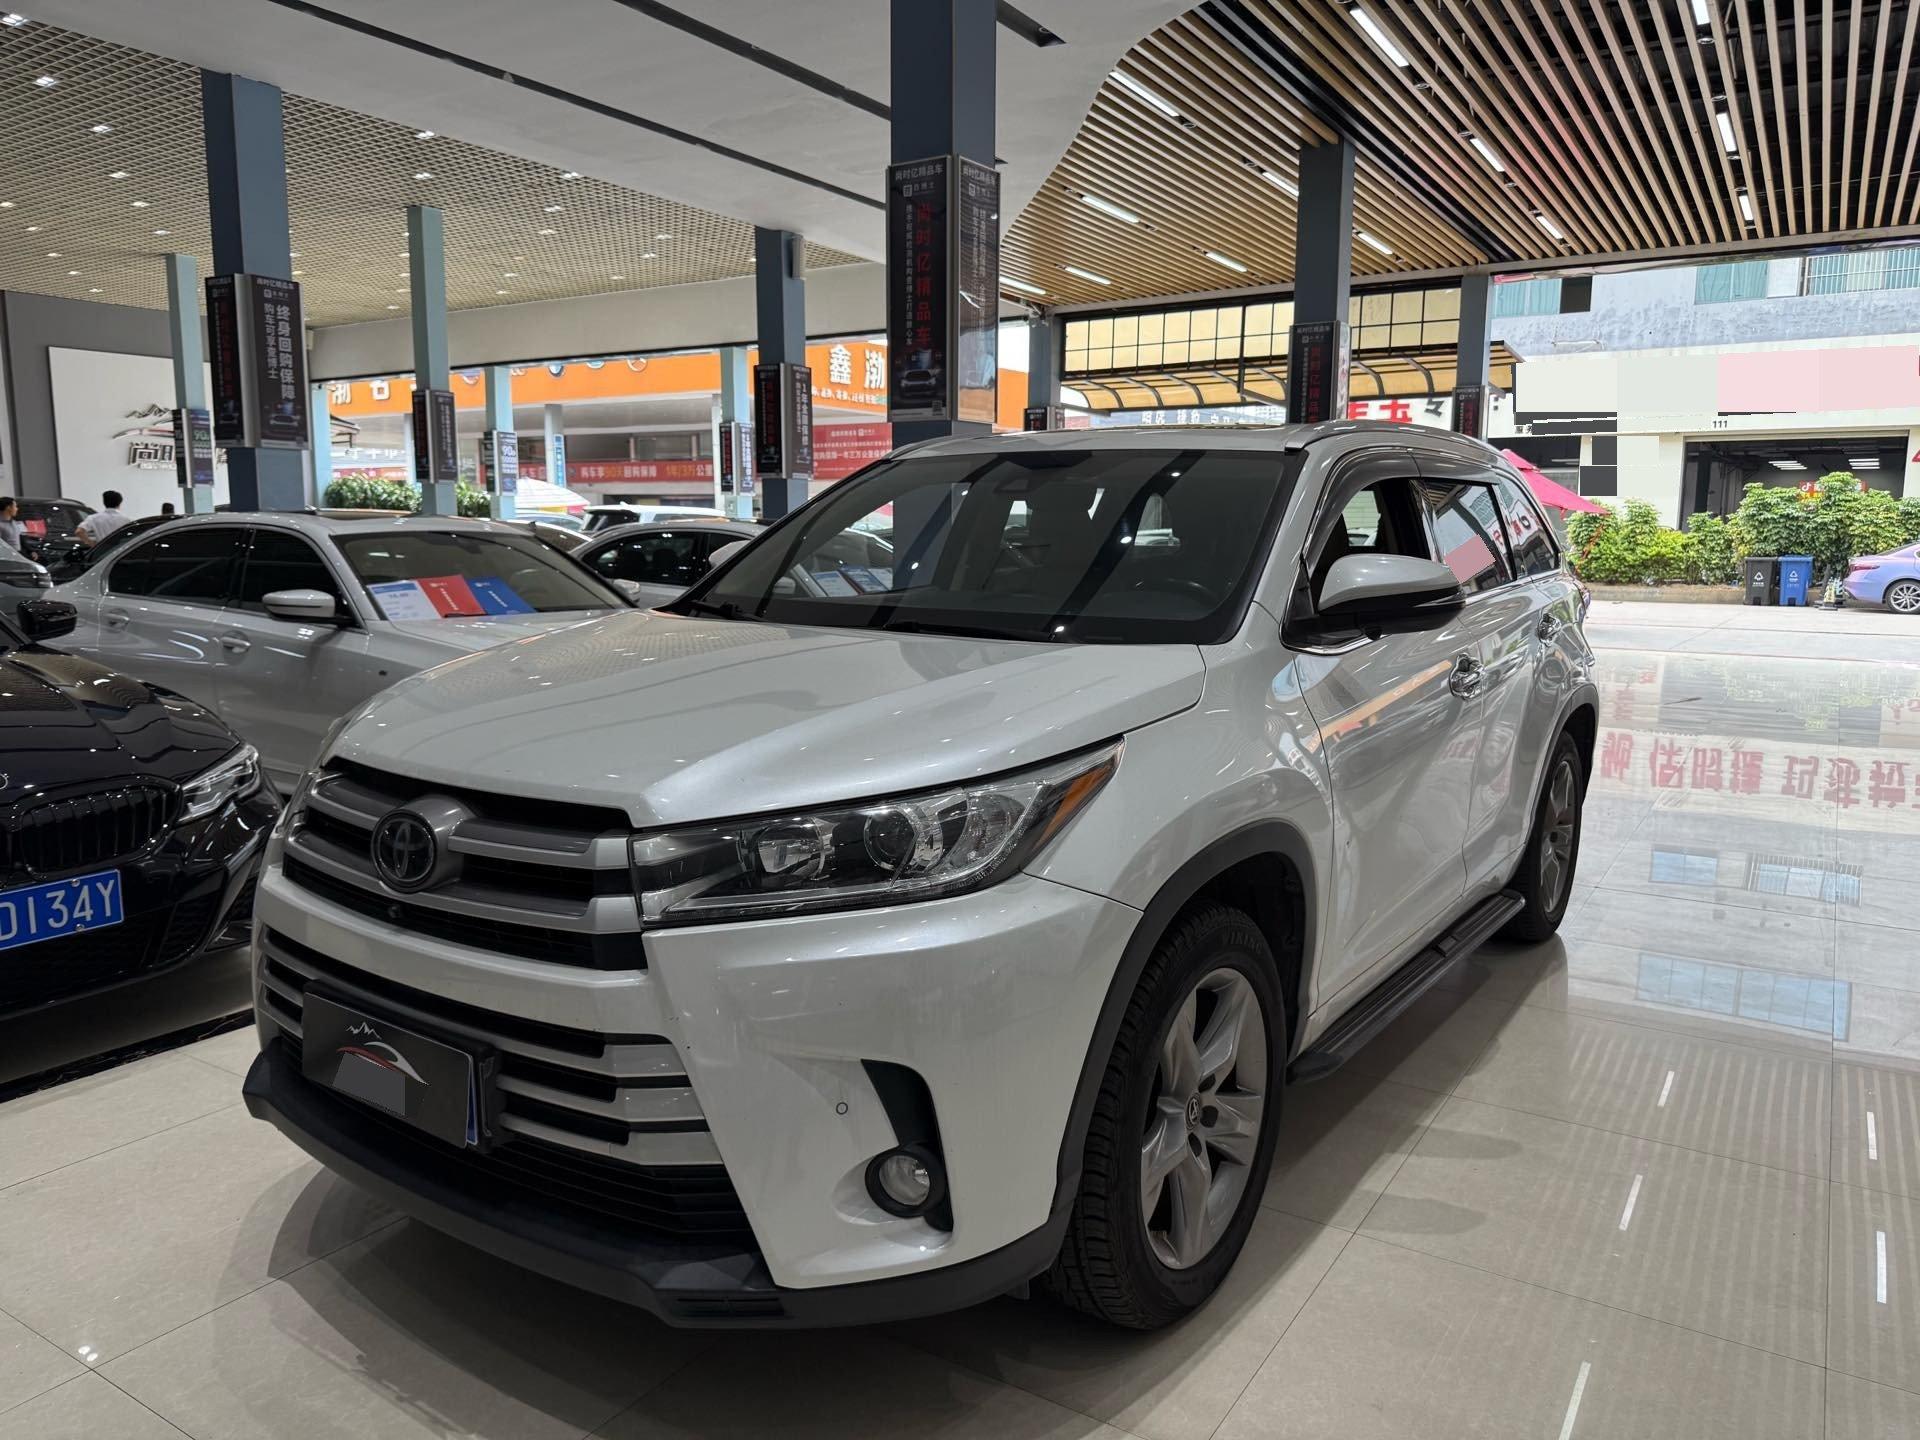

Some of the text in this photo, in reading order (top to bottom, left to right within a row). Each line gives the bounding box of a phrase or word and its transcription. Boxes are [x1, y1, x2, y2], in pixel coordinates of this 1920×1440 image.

[276, 304, 296, 400] 终身回购保障
